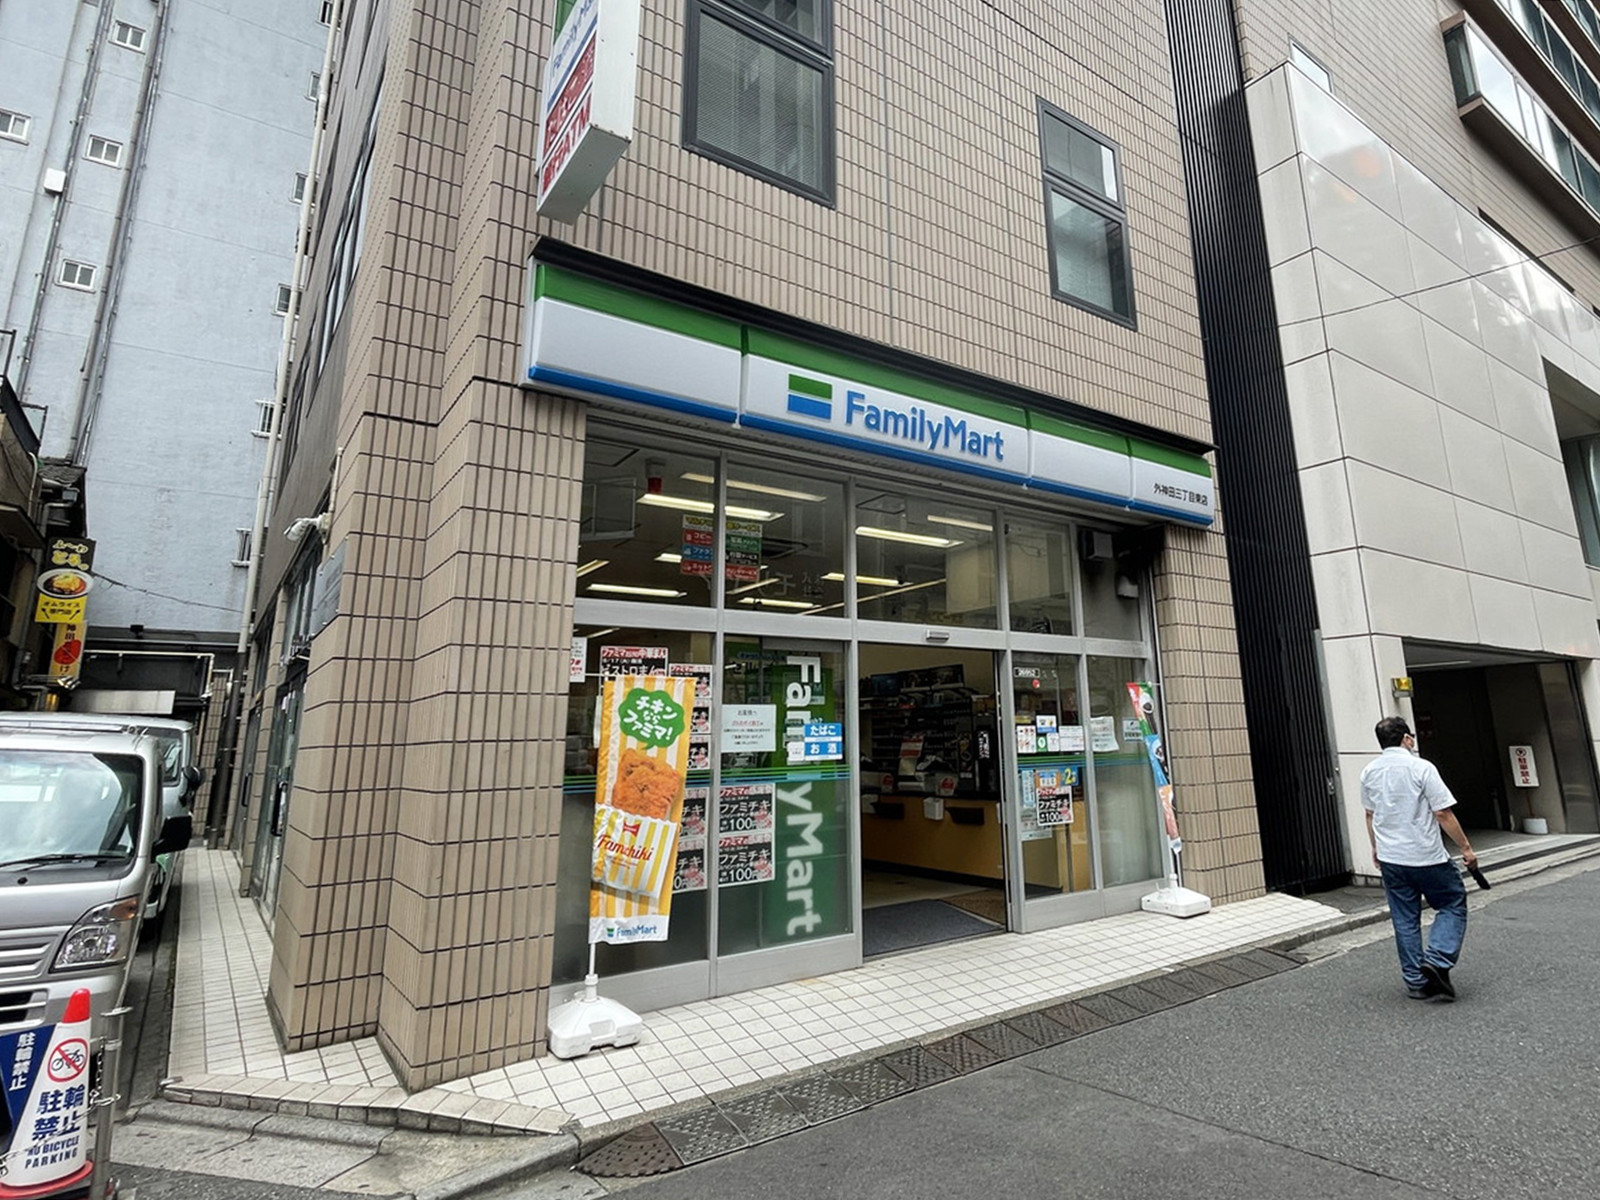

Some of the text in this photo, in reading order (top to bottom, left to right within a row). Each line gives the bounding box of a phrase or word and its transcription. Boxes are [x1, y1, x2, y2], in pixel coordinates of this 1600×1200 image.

[845, 389, 1005, 462] FamilyMart
[1153, 482, 1208, 506] 外神田三丁目東店
[636, 696, 678, 720] チキン
[810, 725, 837, 736] たばこ
[719, 800, 772, 814] ファミチキ
[718, 848, 771, 865] ファミチキ
[9, 1031, 36, 1091] 駐輪禁止
[36, 1083, 86, 1115] 駐輪
[31, 1110, 81, 1142] 禁止
[42, 1135, 80, 1154] BICYCLE
[25, 1147, 79, 1169] PARKING
